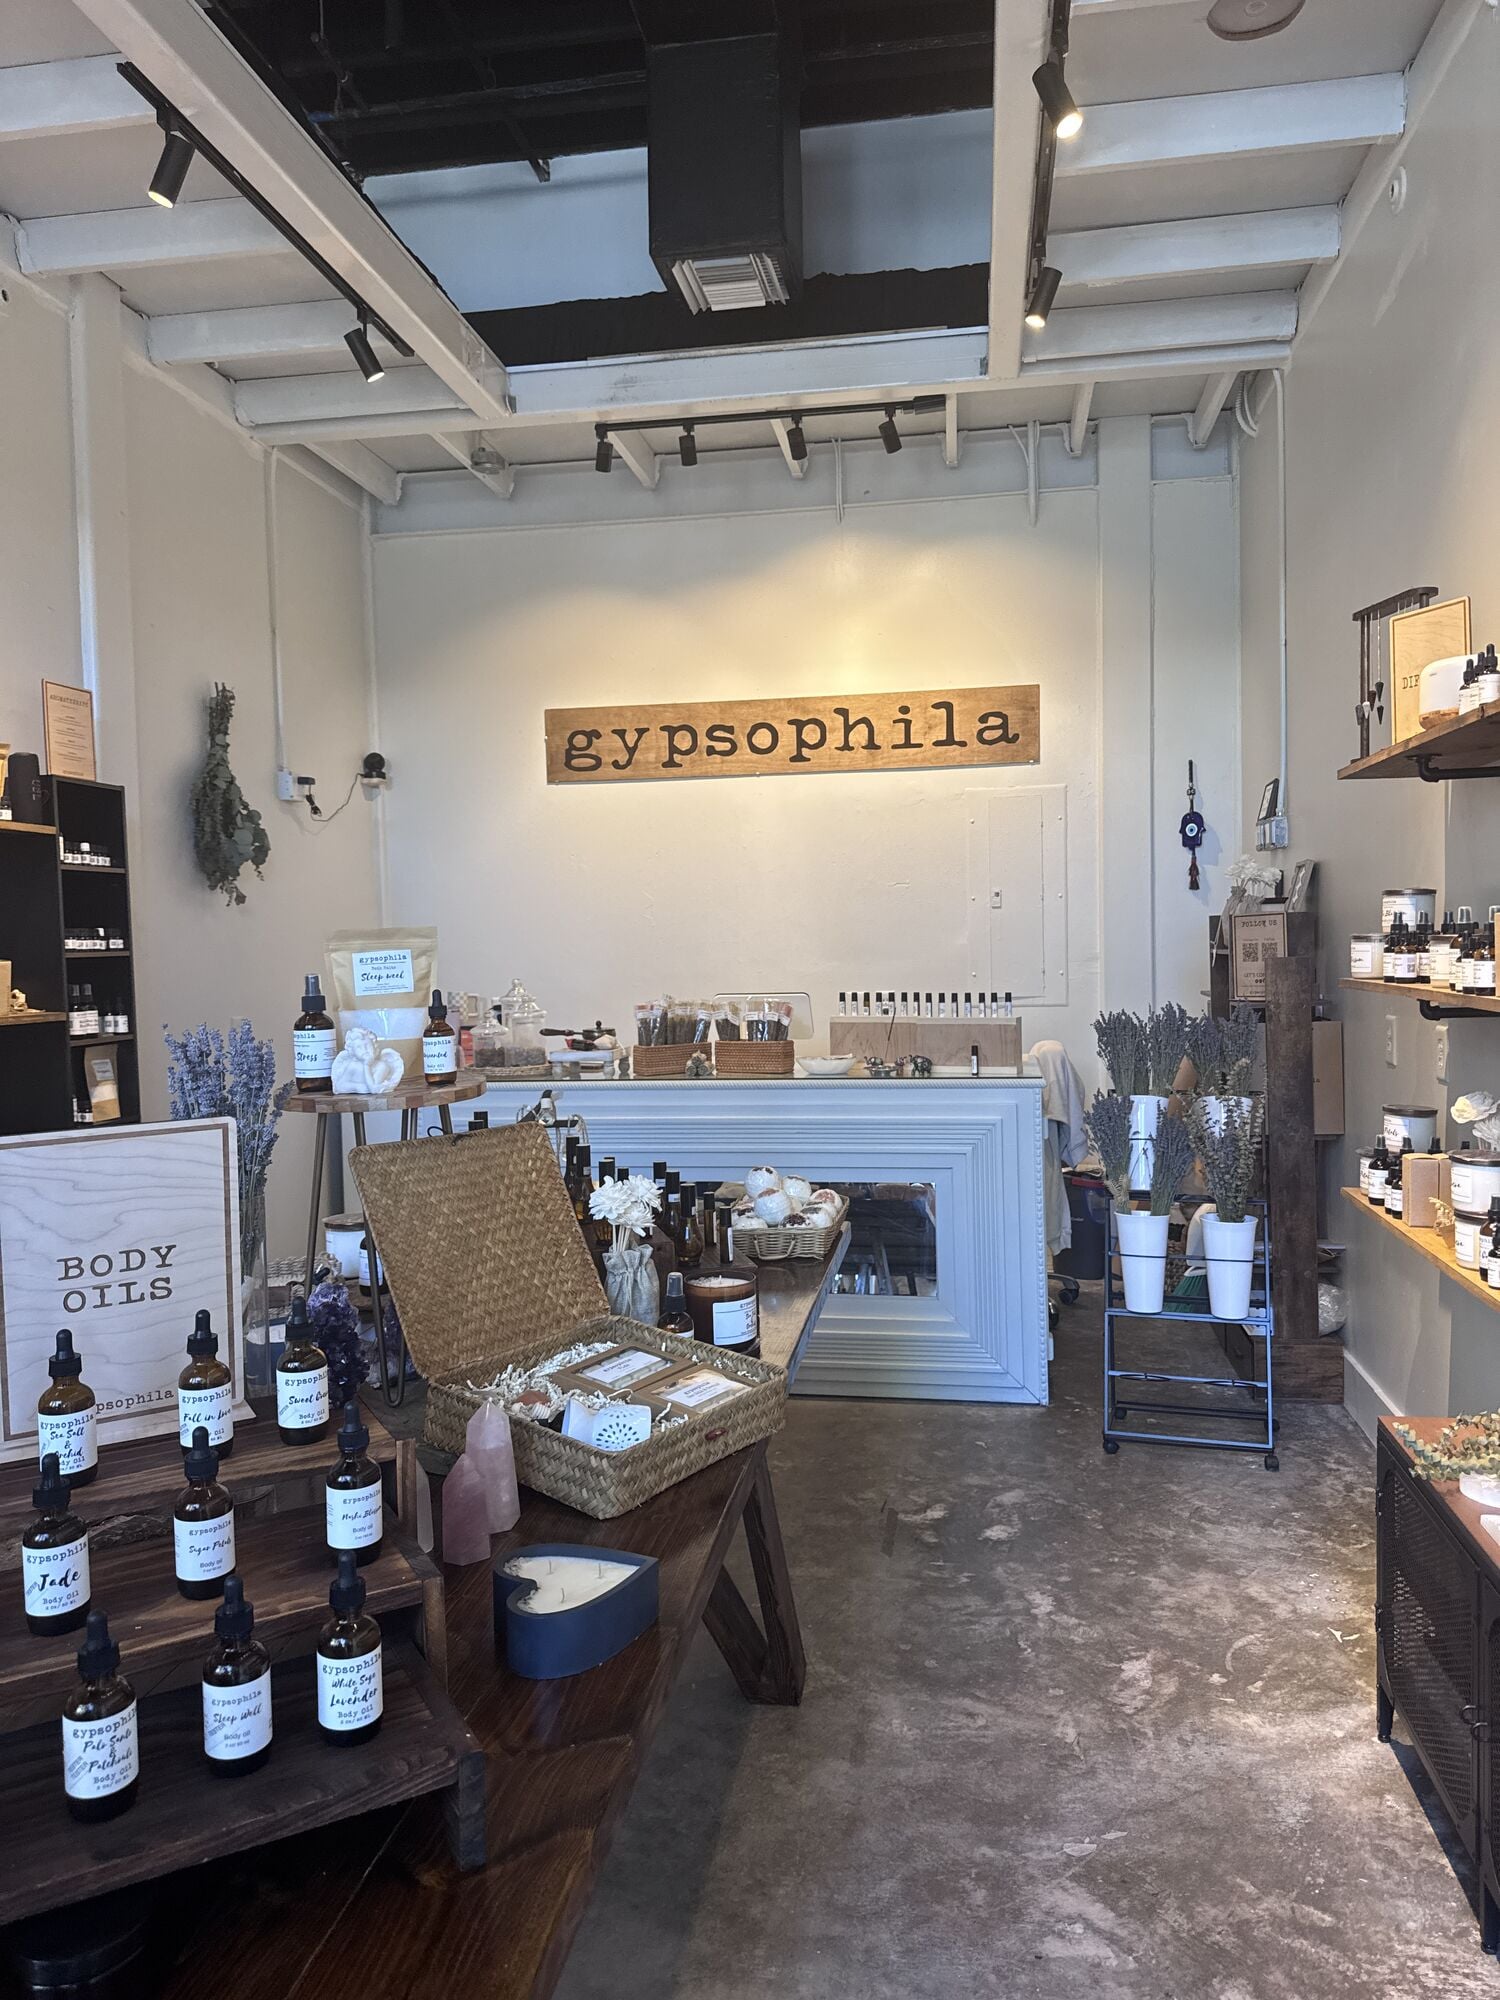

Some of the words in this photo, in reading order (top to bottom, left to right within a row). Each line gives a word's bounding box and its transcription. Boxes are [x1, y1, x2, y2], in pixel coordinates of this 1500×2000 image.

[563, 700, 1020, 772] gypsophila
[1241, 920, 1266, 928] FOLLOW
[359, 953, 408, 964] gypsophila
[360, 972, 384, 983] Sleep
[56, 1243, 177, 1281] BODY
[62, 1276, 173, 1314] OILS
[95, 1389, 175, 1414] psophila
[288, 1393, 314, 1406] Sweet
[40, 1414, 95, 1431] gypsophila
[183, 1412, 202, 1423] Fall
[299, 1412, 315, 1421] Body
[65, 1426, 85, 1439] Salt
[188, 1519, 231, 1537] gypsophila
[26, 1541, 87, 1564] gypsophila
[188, 1545, 211, 1556] Sugar
[37, 1567, 81, 1592] Jade
[42, 1596, 64, 1605] Body
[66, 1590, 80, 1600] Oil
[331, 1678, 358, 1689] White
[211, 1690, 263, 1707] gypsophila
[330, 1687, 379, 1708] Lavender
[337, 1709, 359, 1719] Body
[360, 1703, 374, 1715] Oil
[72, 1707, 137, 1739] gypsophil
[213, 1713, 238, 1726] Sleep
[83, 1739, 108, 1753] Palo
[93, 1772, 117, 1784] Body
[119, 1763, 132, 1775] Oil
